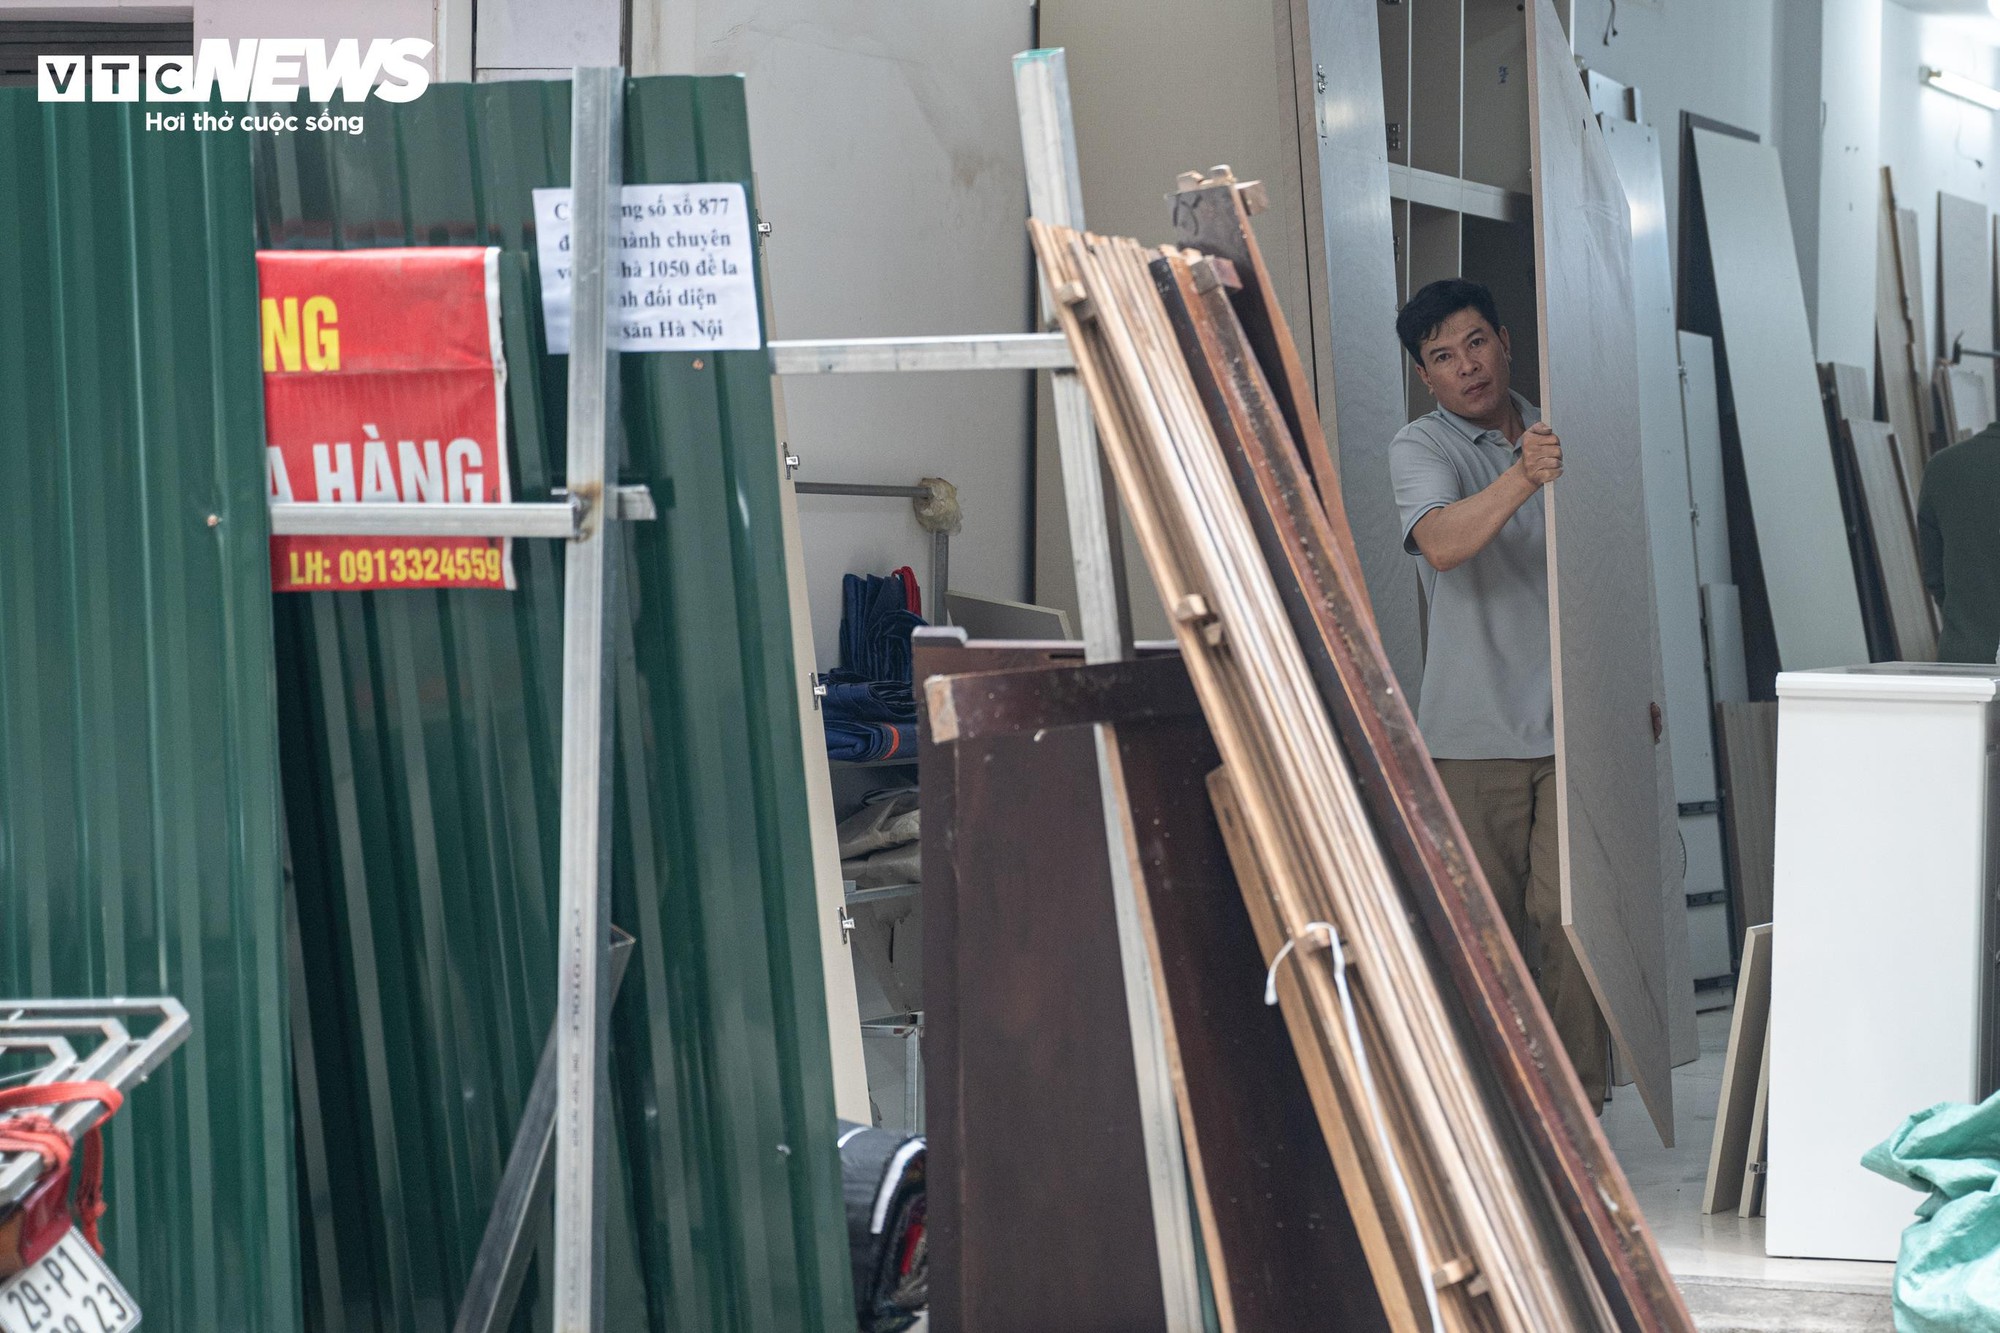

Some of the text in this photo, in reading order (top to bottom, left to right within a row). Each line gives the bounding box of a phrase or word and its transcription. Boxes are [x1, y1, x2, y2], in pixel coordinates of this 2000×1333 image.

[647, 193, 666, 216] số
[698, 198, 730, 216] 877
[649, 260, 690, 278] 1050
[722, 260, 738, 276] la
[644, 284, 672, 307] đối
[678, 289, 717, 310] diện
[261, 296, 341, 373] NG
[659, 321, 685, 339] Hà
[691, 319, 724, 341] Nội
[312, 423, 484, 504] HÀNG
[289, 547, 502, 585] LH: 0913324559
